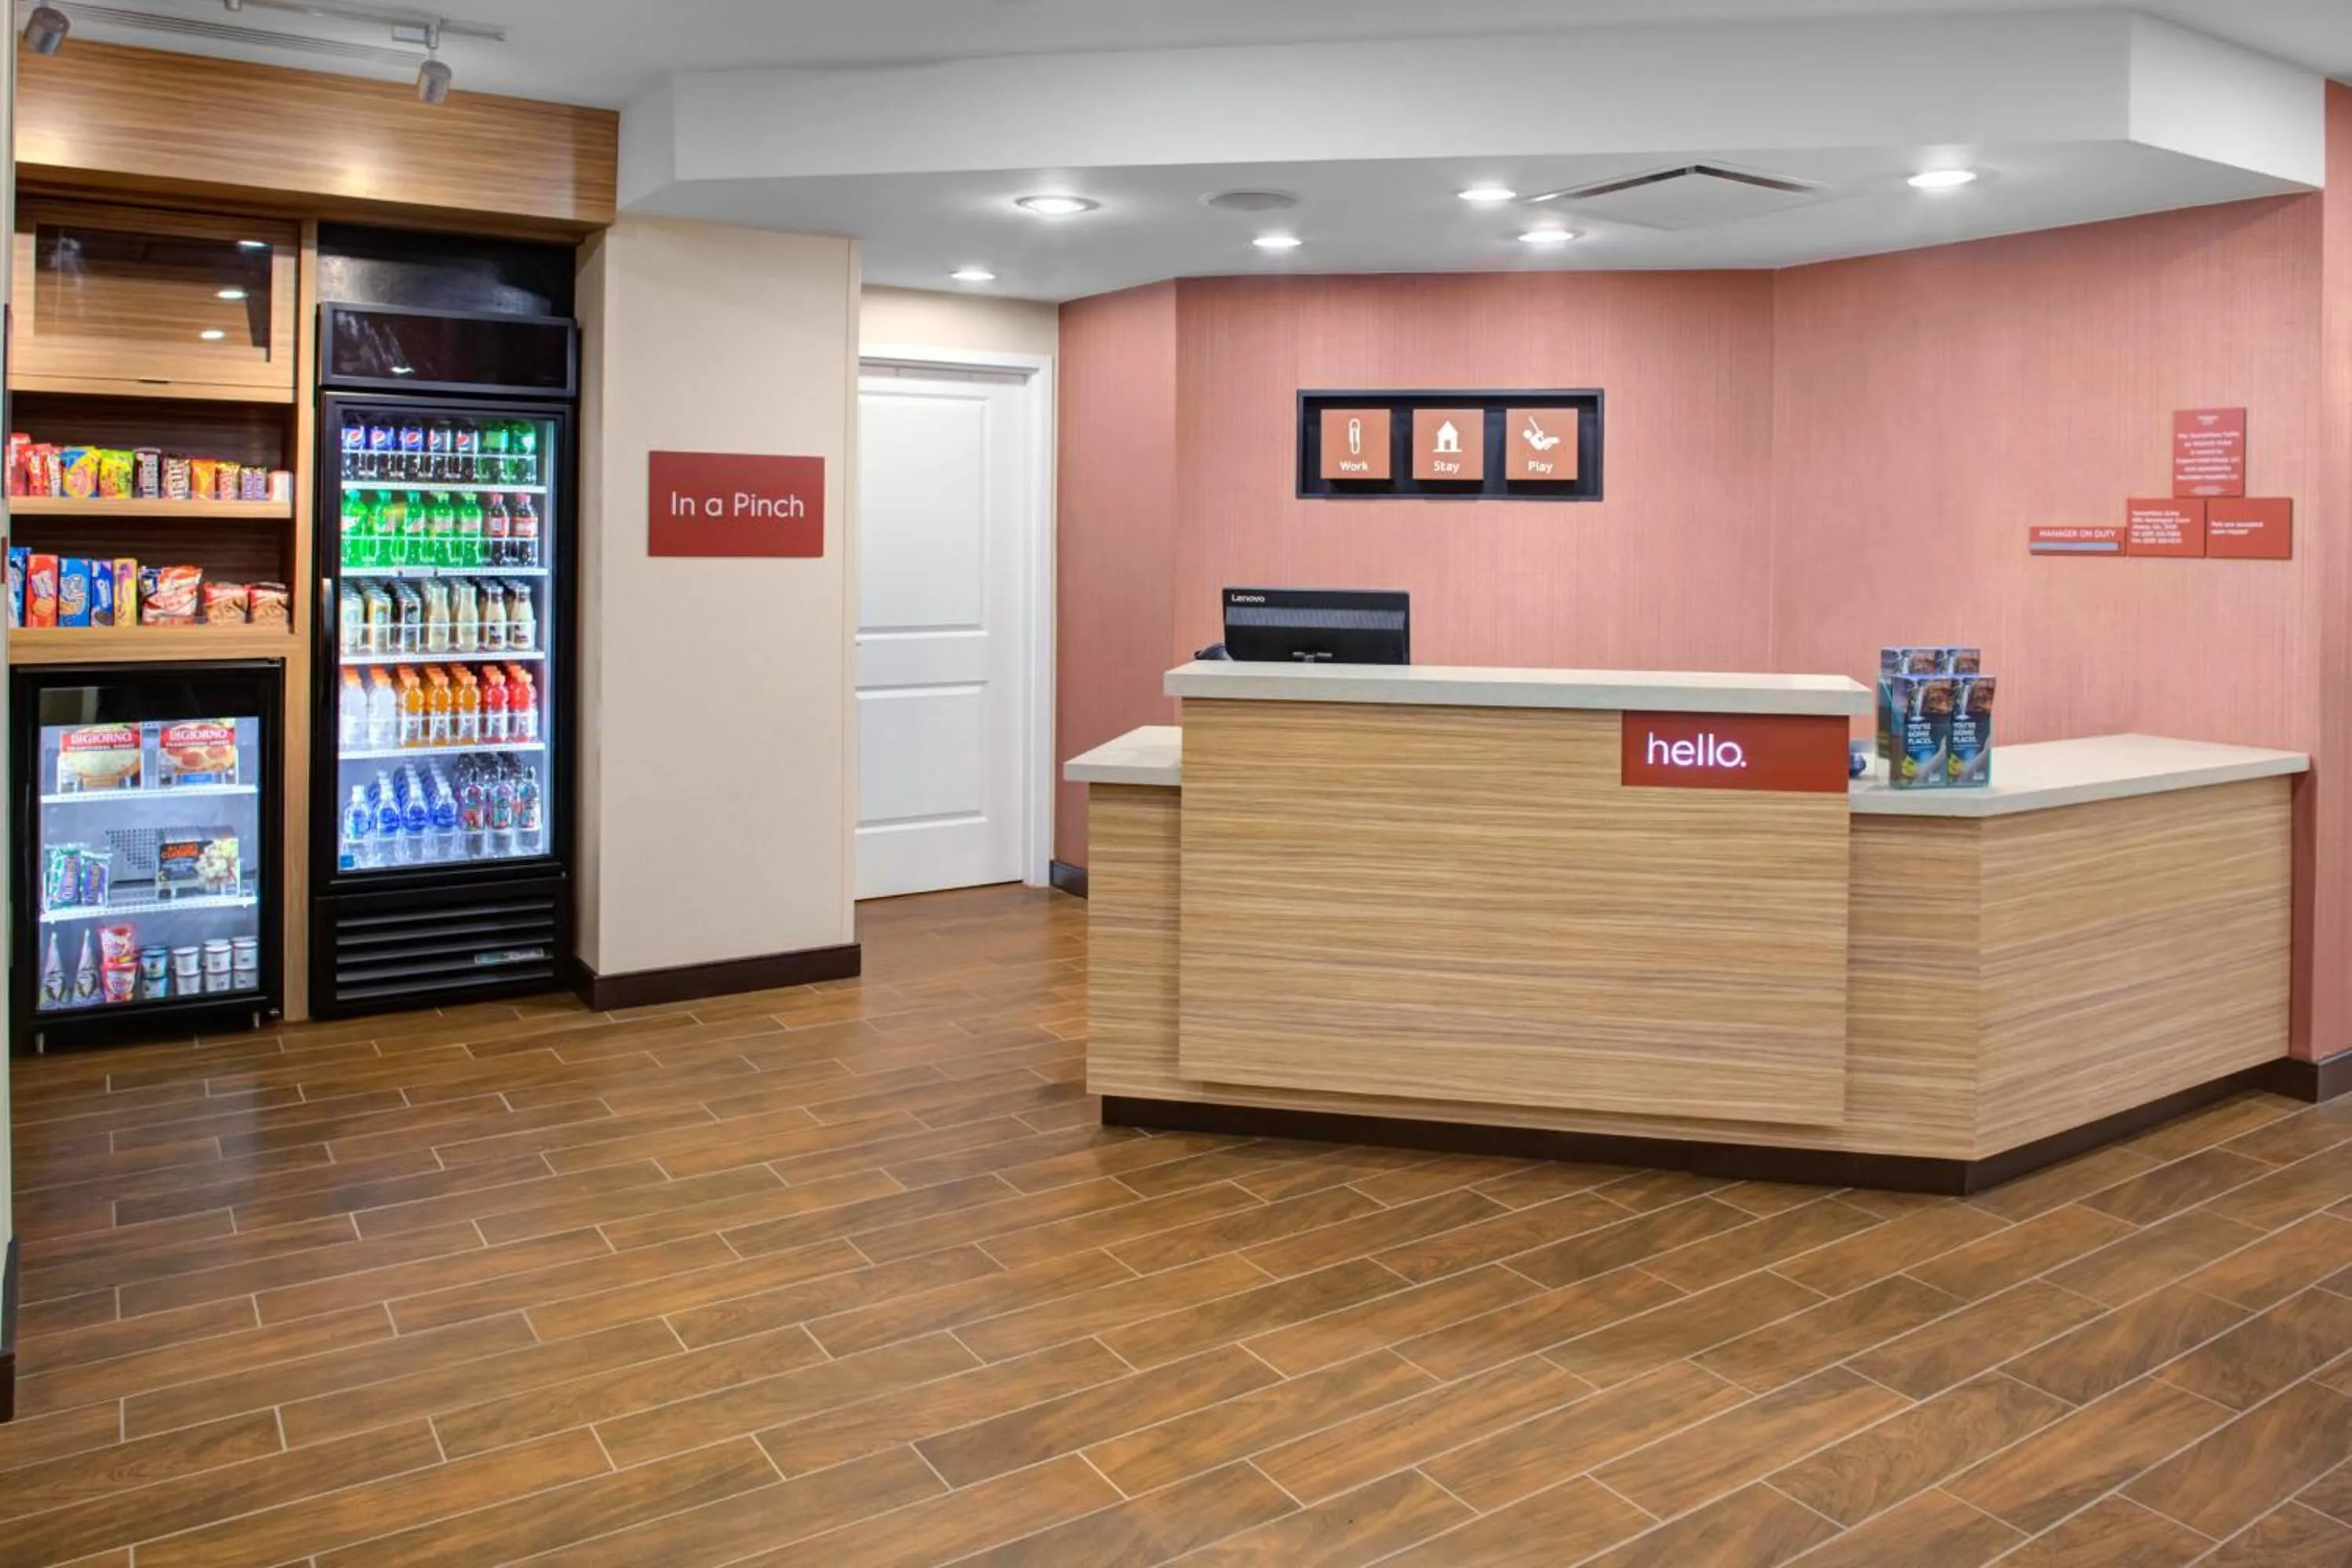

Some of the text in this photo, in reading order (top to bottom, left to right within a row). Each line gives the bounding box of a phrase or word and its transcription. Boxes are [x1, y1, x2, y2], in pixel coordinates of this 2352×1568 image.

[1339, 460, 1369, 472] Work
[1432, 460, 1461, 474] Stay
[1528, 460, 1554, 474] Play
[670, 490, 805, 518] In a Pinch
[2038, 529, 2116, 539] MANAGER ON DUTY
[1231, 593, 1266, 603] Lenovo
[1646, 731, 1748, 768] hello.
